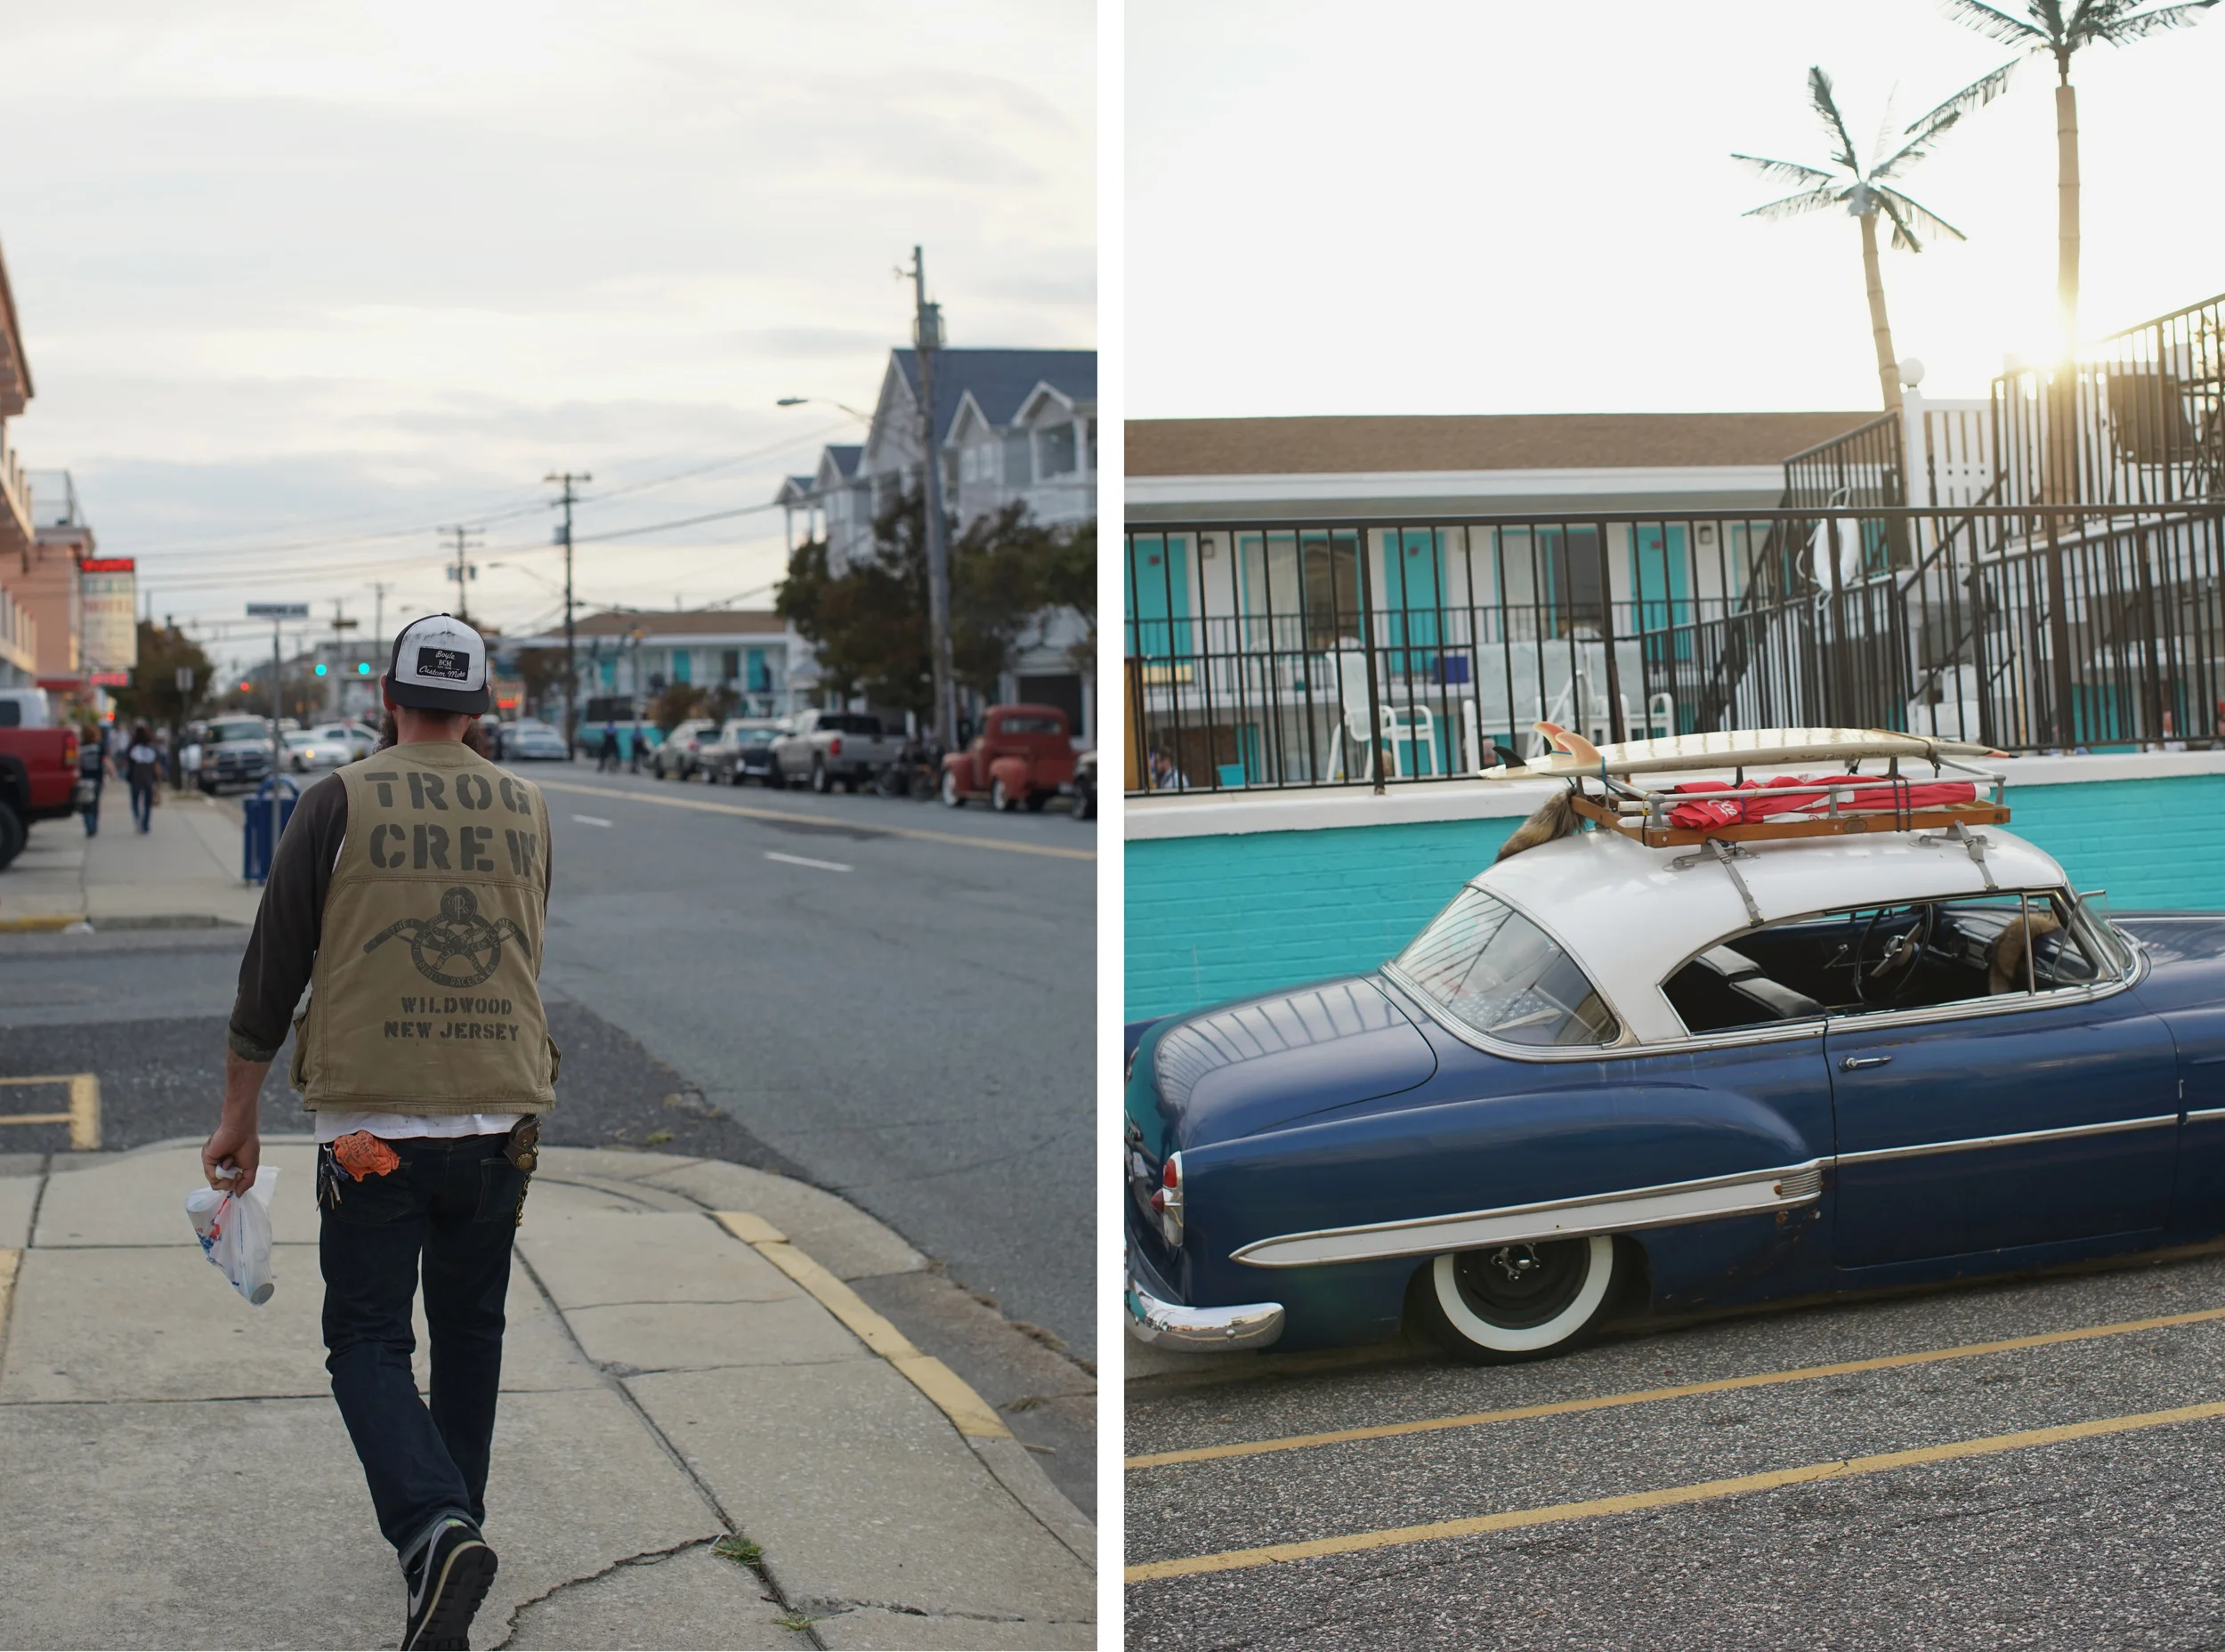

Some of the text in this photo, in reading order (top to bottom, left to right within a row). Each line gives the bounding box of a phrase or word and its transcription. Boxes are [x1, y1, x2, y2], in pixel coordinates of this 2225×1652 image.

[435, 650, 456, 660] Boyle
[438, 659, 452, 667] BCM
[419, 665, 446, 677] Custom
[364, 772, 532, 815] TROG
[369, 823, 537, 878] CREW
[450, 977, 473, 988] RACE
[400, 996, 513, 1016] WILDWOOD
[384, 1020, 520, 1041] NEW JERSEY
